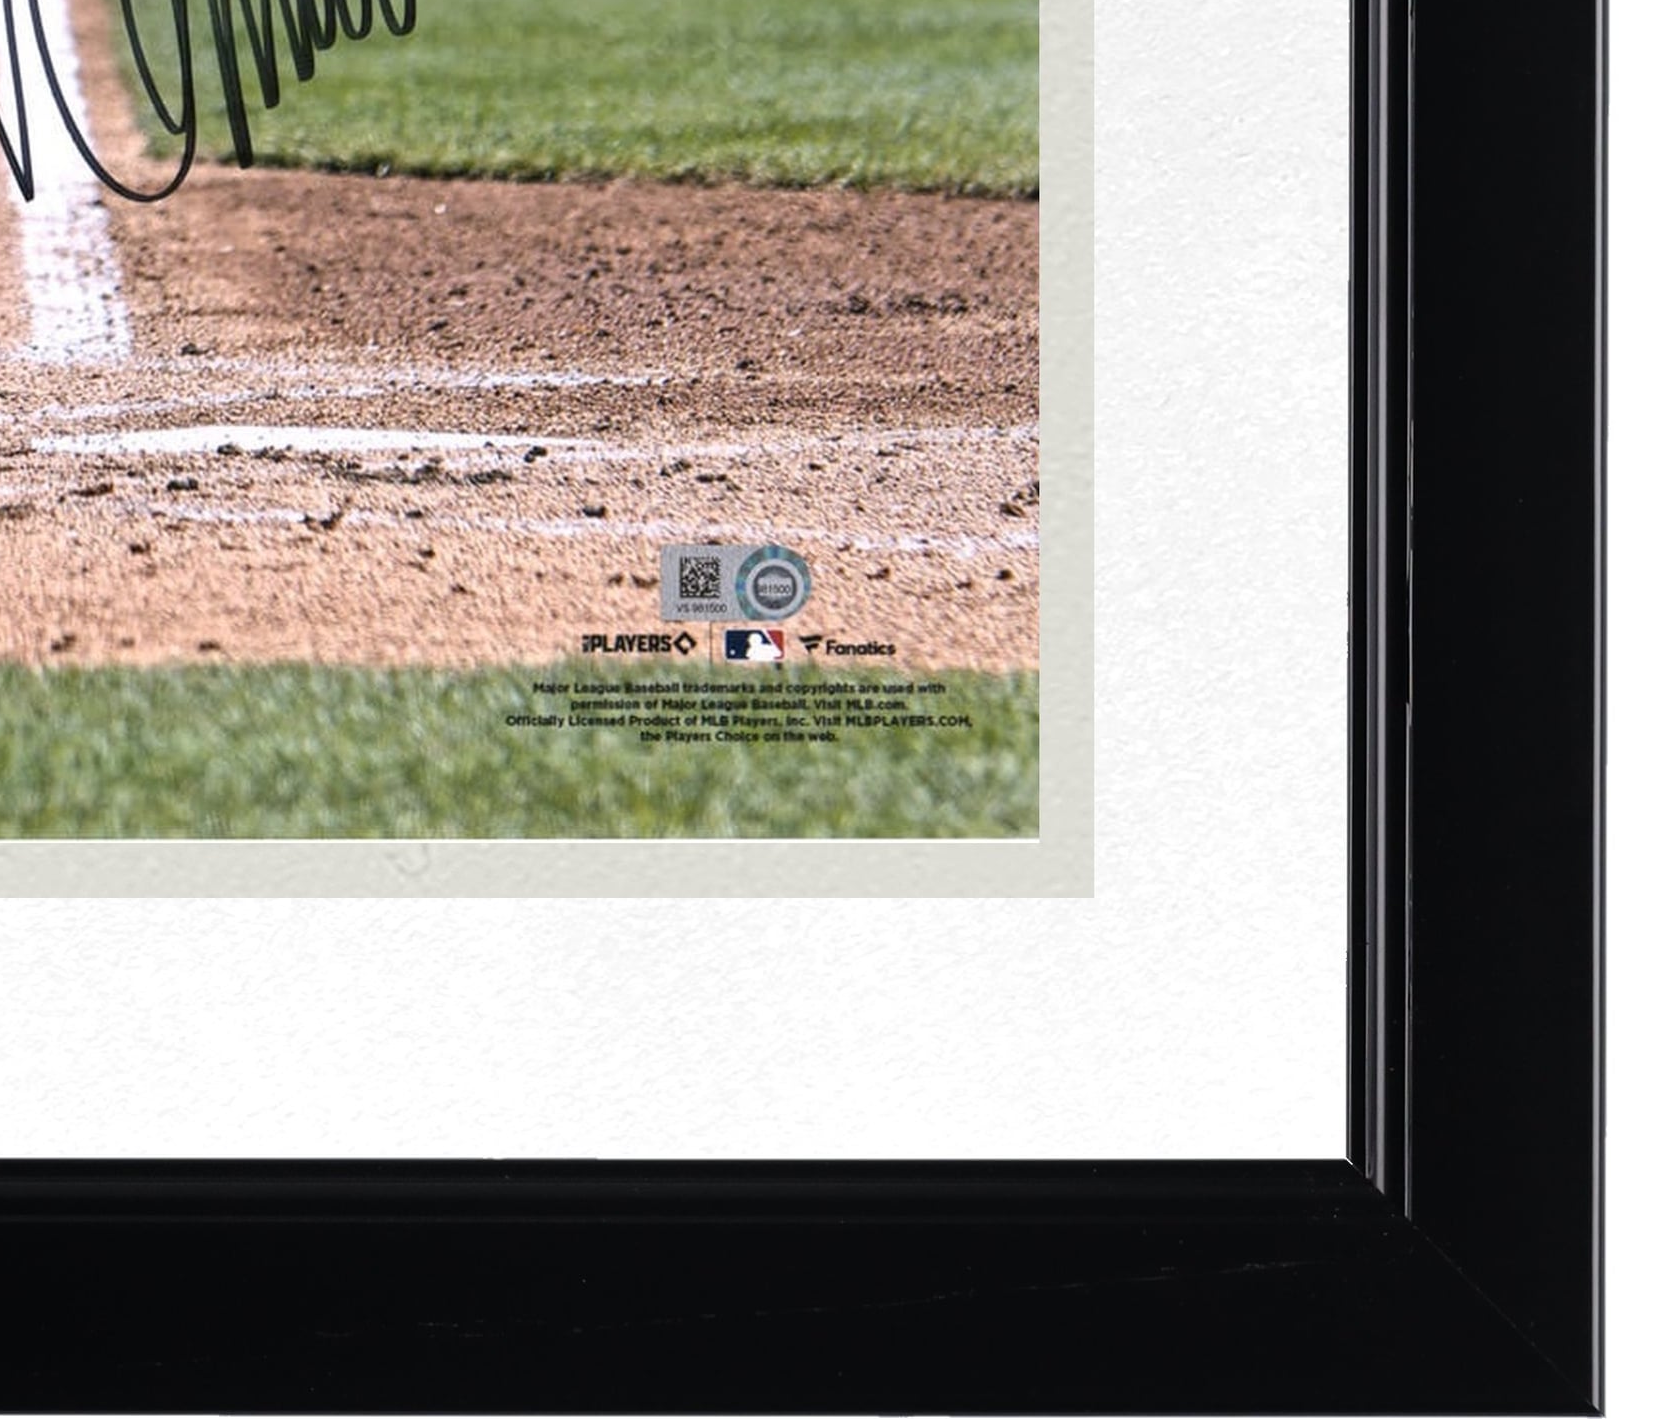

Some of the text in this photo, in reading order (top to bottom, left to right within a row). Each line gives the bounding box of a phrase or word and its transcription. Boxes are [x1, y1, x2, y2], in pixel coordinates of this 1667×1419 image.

[826, 639, 896, 655] Fanatics
[533, 682, 946, 695] Major League Baseball trademarks and copyrights are used with
[571, 698, 640, 711] permission
[645, 699, 658, 709] of
[662, 699, 697, 711] Major
[701, 699, 748, 711] League
[814, 699, 841, 709] Visit
[506, 715, 564, 728] Officially
[569, 715, 625, 726] Licensed
[630, 715, 680, 726] Product
[684, 715, 697, 726] of
[701, 715, 728, 726] MLB
[814, 715, 841, 726] Visit
[640, 731, 661, 741] the
[665, 731, 711, 743] Players
[716, 731, 759, 742] Choice
[763, 733, 781, 742] on
[783, 731, 805, 741] the
